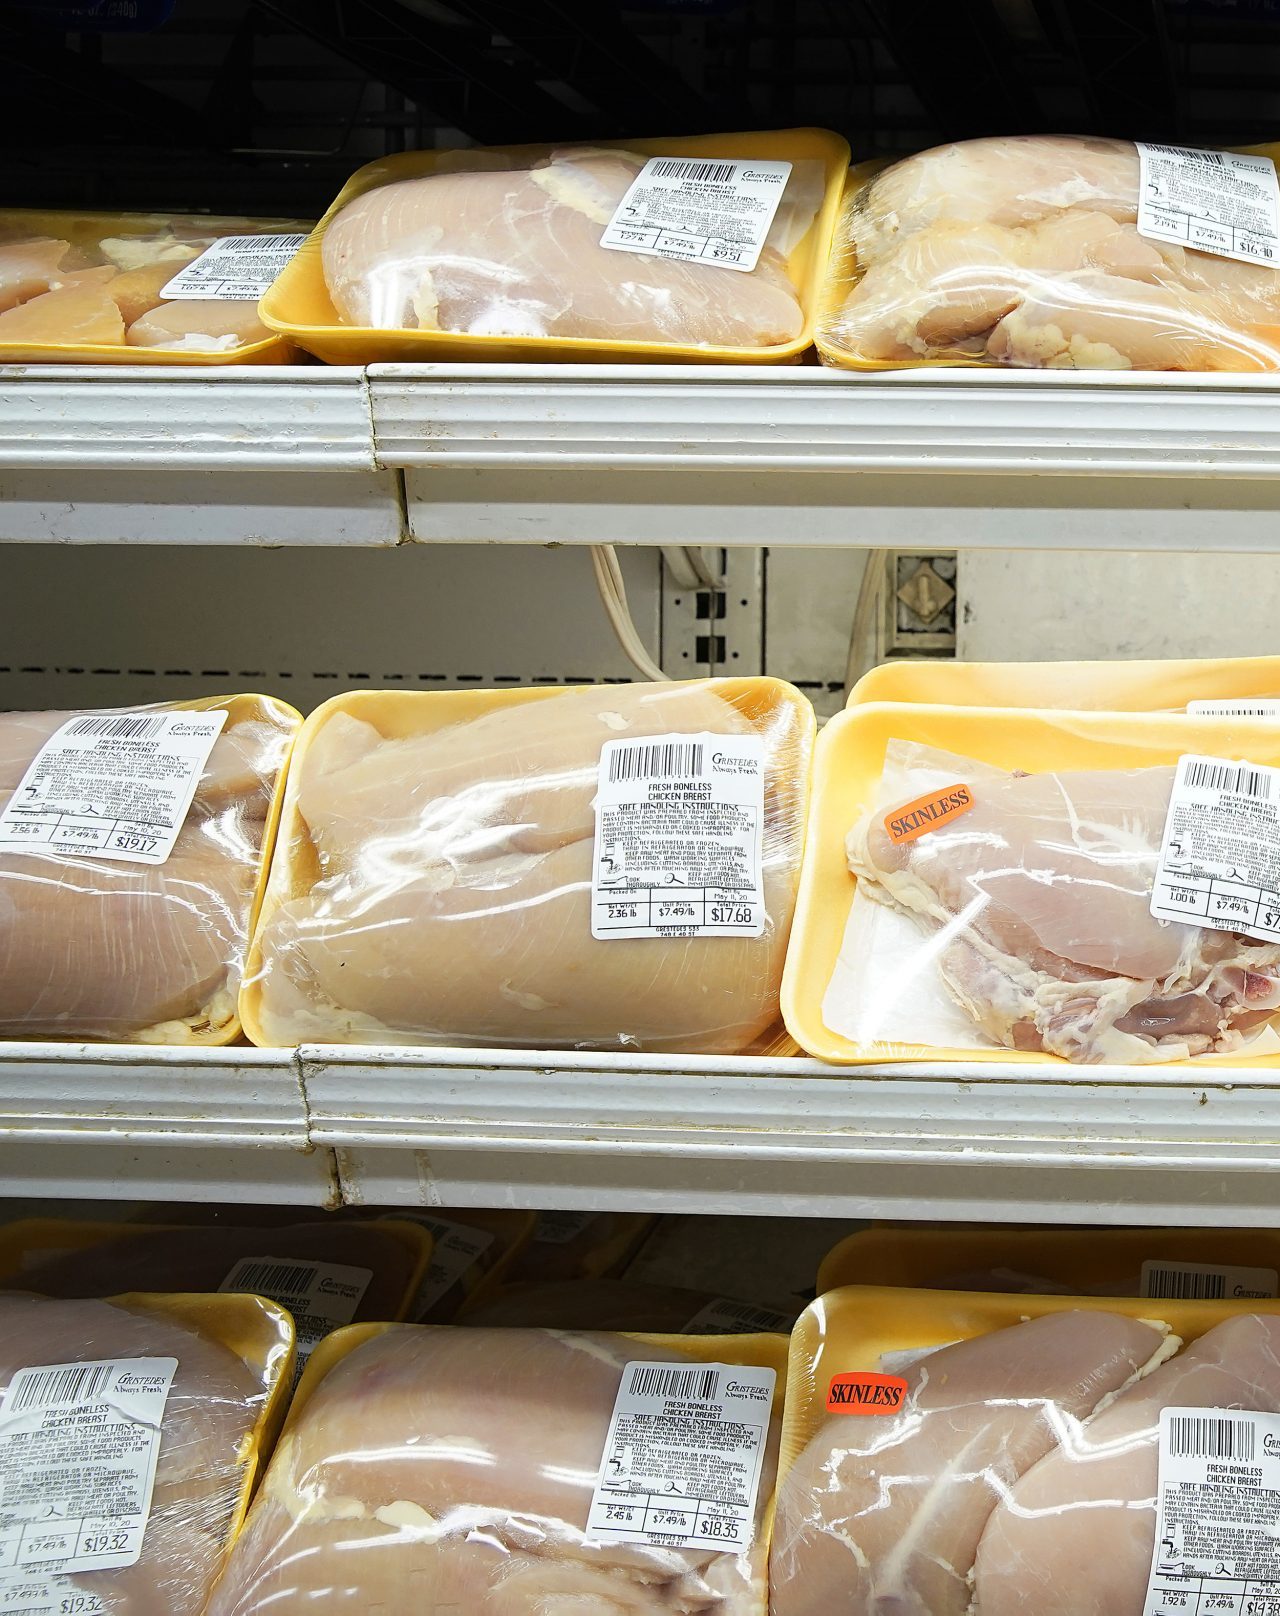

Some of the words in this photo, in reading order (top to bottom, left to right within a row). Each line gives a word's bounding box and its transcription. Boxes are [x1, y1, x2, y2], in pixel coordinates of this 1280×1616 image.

[1196, 230, 1225, 242] $7.49/lb
[713, 250, 742, 261] $9.51
[170, 723, 215, 732] GRISTEDES
[712, 753, 758, 767] GRISTEDES
[712, 766, 736, 774] Always
[738, 767, 758, 775] Fresh
[648, 783, 671, 791] FRESH
[674, 783, 712, 791] BONELESS
[682, 803, 738, 811] INSTRUCTIONS
[1219, 801, 1249, 811] CHICKEN
[1251, 806, 1277, 817] BREAST
[1220, 795, 1242, 803] FRESH
[1242, 798, 1277, 811] BONELESS
[890, 789, 969, 838] SKINLESS
[62, 830, 99, 840] $7.49/lb
[115, 837, 157, 851] $19.17
[1170, 892, 1187, 902] 1.00
[1189, 896, 1195, 904] lb
[659, 907, 695, 916] $7.49/lb
[1216, 901, 1249, 914] $7.49/lb
[608, 910, 628, 918] 2.36
[711, 908, 752, 922] $17.68
[118, 1373, 166, 1385] GRISTEDES
[726, 1382, 769, 1395] GRISTEDES
[725, 1392, 748, 1400] Always
[829, 1384, 902, 1406] SKINLESS
[44, 1408, 67, 1419] FRESH
[68, 1405, 109, 1417] BONELESS
[688, 1403, 723, 1412] BONELESS
[663, 1408, 693, 1417] CHICKEN
[695, 1411, 721, 1420] BREAST
[41, 1417, 75, 1428] CHICKEN
[77, 1415, 107, 1425] BREAST
[654, 1416, 690, 1424] HANDLING
[692, 1419, 746, 1430] INSTRUCTIONS
[1207, 1464, 1227, 1473] FRESH
[1229, 1466, 1263, 1476] BONELESS
[1207, 1474, 1236, 1484] CHICKEN
[1238, 1477, 1262, 1486] BREAST
[1180, 1483, 1196, 1491] SAFE
[1199, 1484, 1234, 1494] HANDLING
[606, 1510, 625, 1520] 2.45
[626, 1512, 632, 1520] lb
[653, 1515, 687, 1526] $7.49/lb
[701, 1521, 739, 1538] $18.35
[84, 1534, 129, 1551] $19.32
[1252, 1587, 1267, 1595] May
[1162, 1596, 1178, 1605] 1.92
[1180, 1598, 1186, 1606] lb
[1205, 1600, 1234, 1609] $7.49/lb
[1247, 1602, 1280, 1614] $1438
